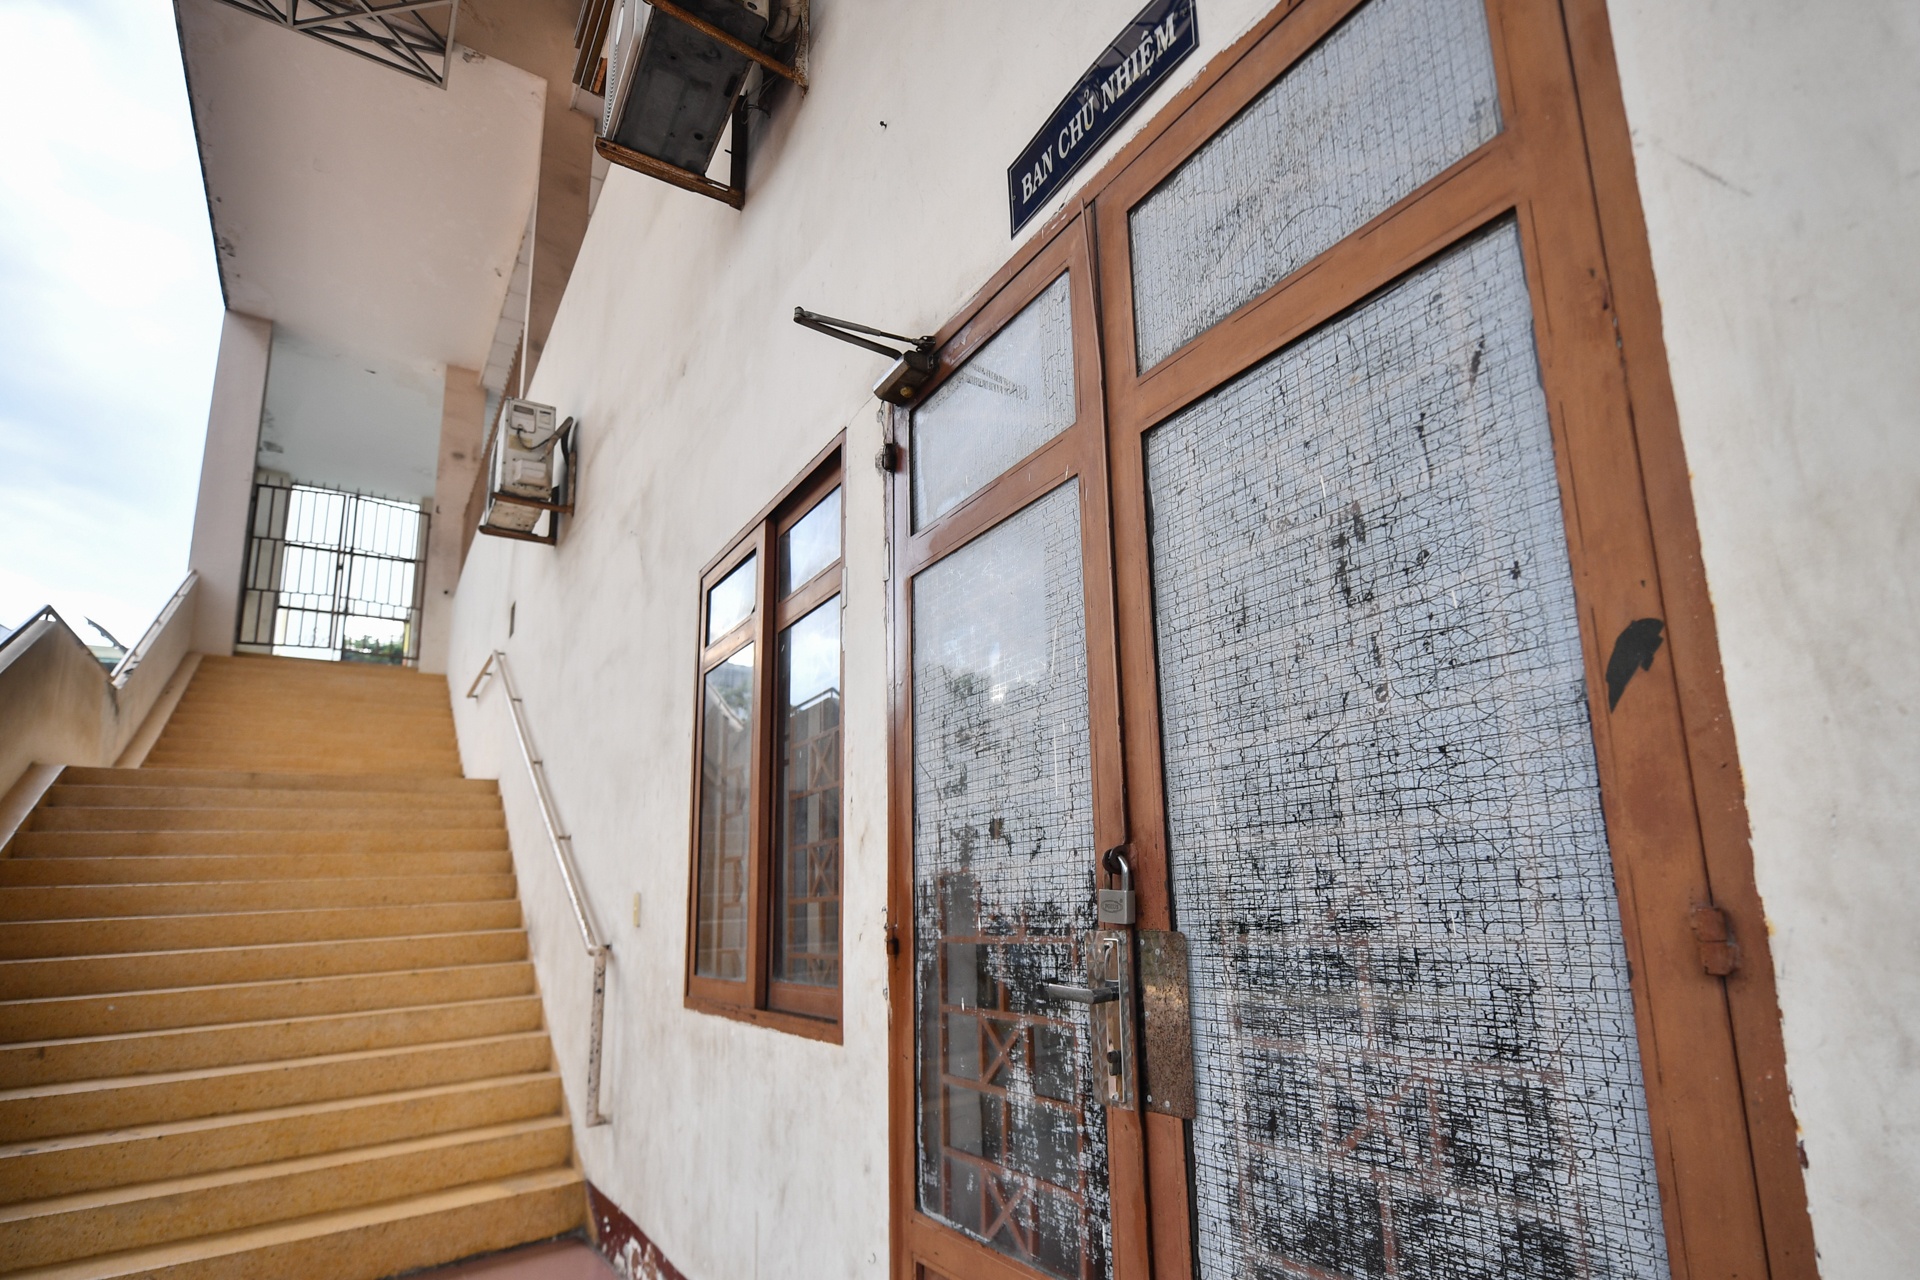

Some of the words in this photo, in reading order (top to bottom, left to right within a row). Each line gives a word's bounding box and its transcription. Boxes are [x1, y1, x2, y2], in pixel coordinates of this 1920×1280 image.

[1021, 144, 1053, 205] BAN
[1058, 89, 1095, 159] CHỦ
[1101, 11, 1177, 113] NHIỆM
